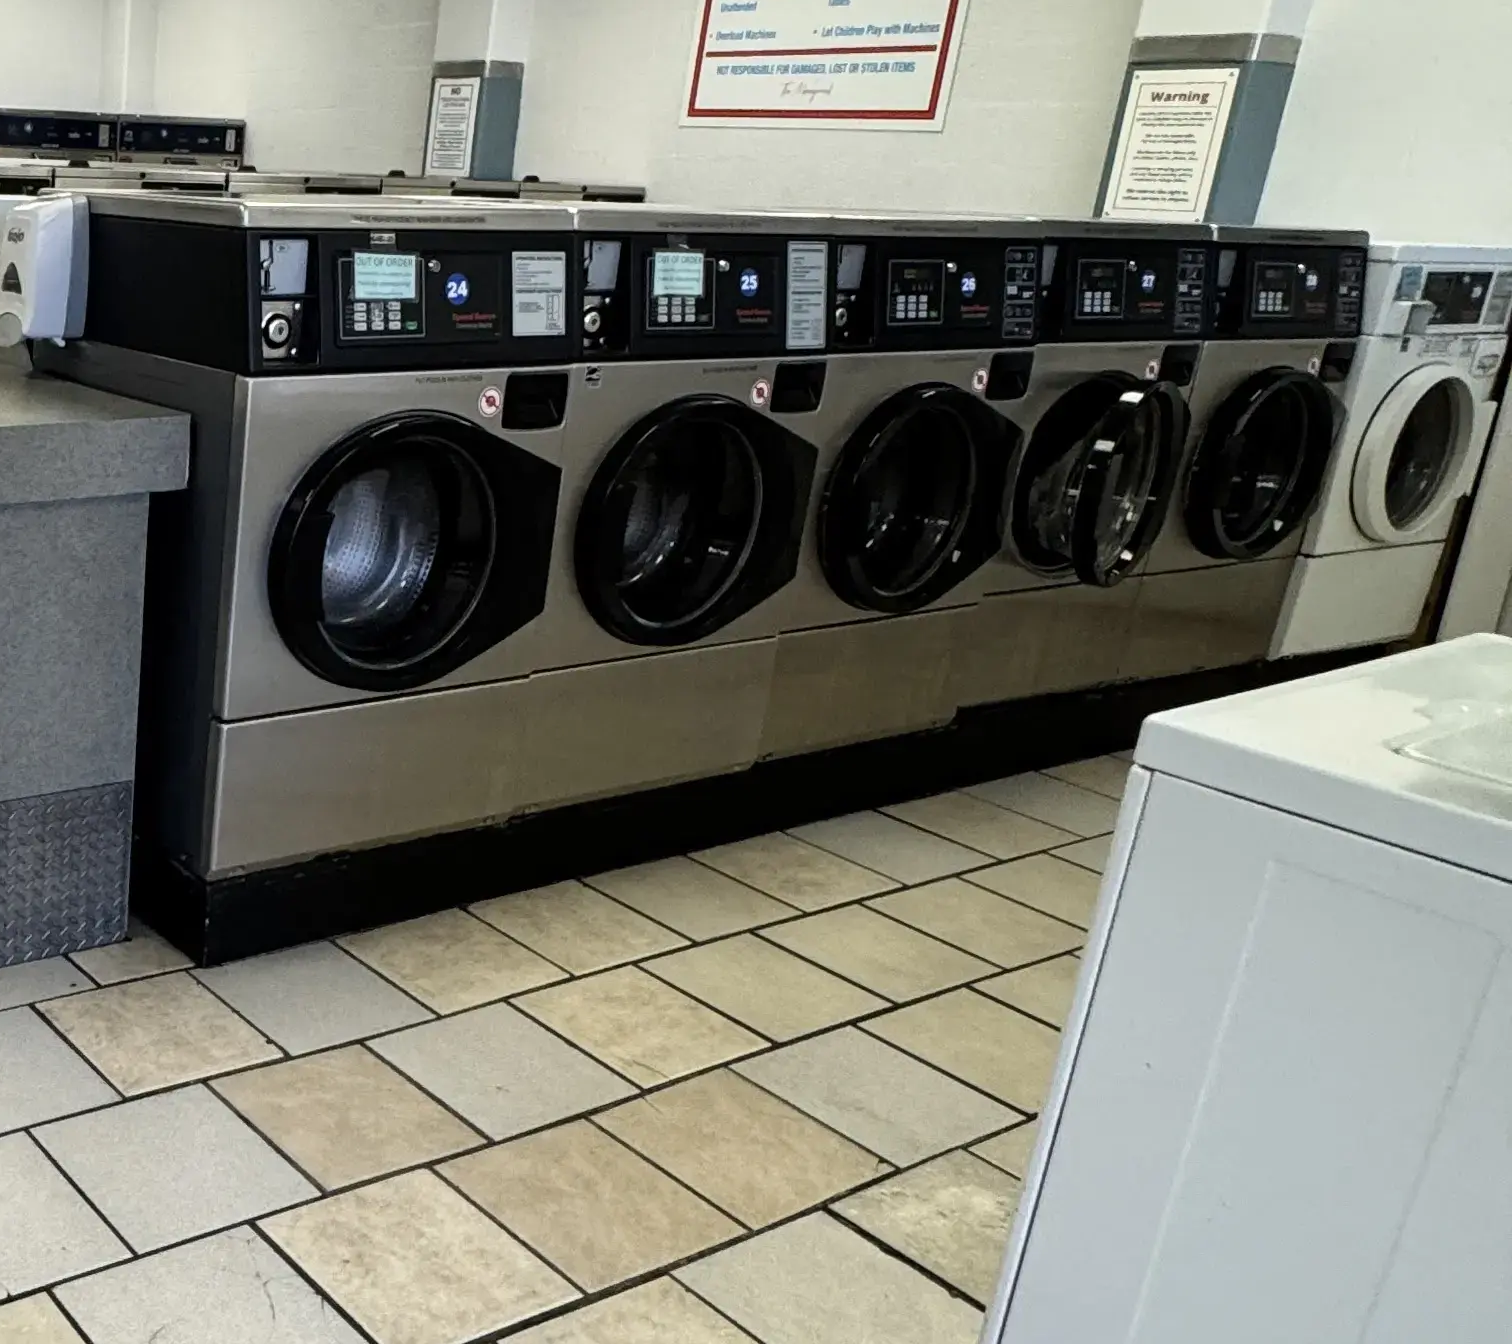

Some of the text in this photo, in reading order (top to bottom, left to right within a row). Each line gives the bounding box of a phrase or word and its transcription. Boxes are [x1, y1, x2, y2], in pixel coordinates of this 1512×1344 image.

[745, 29, 777, 40] Machines
[821, 22, 941, 38] Let Children Play with Machines
[730, 64, 775, 75] RESPONSIBLE
[775, 64, 790, 74] FOR
[829, 63, 848, 74] LOST
[848, 63, 860, 73] OR
[860, 62, 890, 74] STOLEN
[890, 62, 916, 73] ITEMS
[1151, 91, 1210, 104] Warning
[356, 257, 413, 268] OUT OF ORDER
[657, 256, 669, 265] OUT
[671, 256, 680, 265] OF
[740, 274, 758, 291] 25
[961, 277, 977, 292] 26
[1141, 274, 1156, 289] 27
[447, 280, 469, 299] 24
